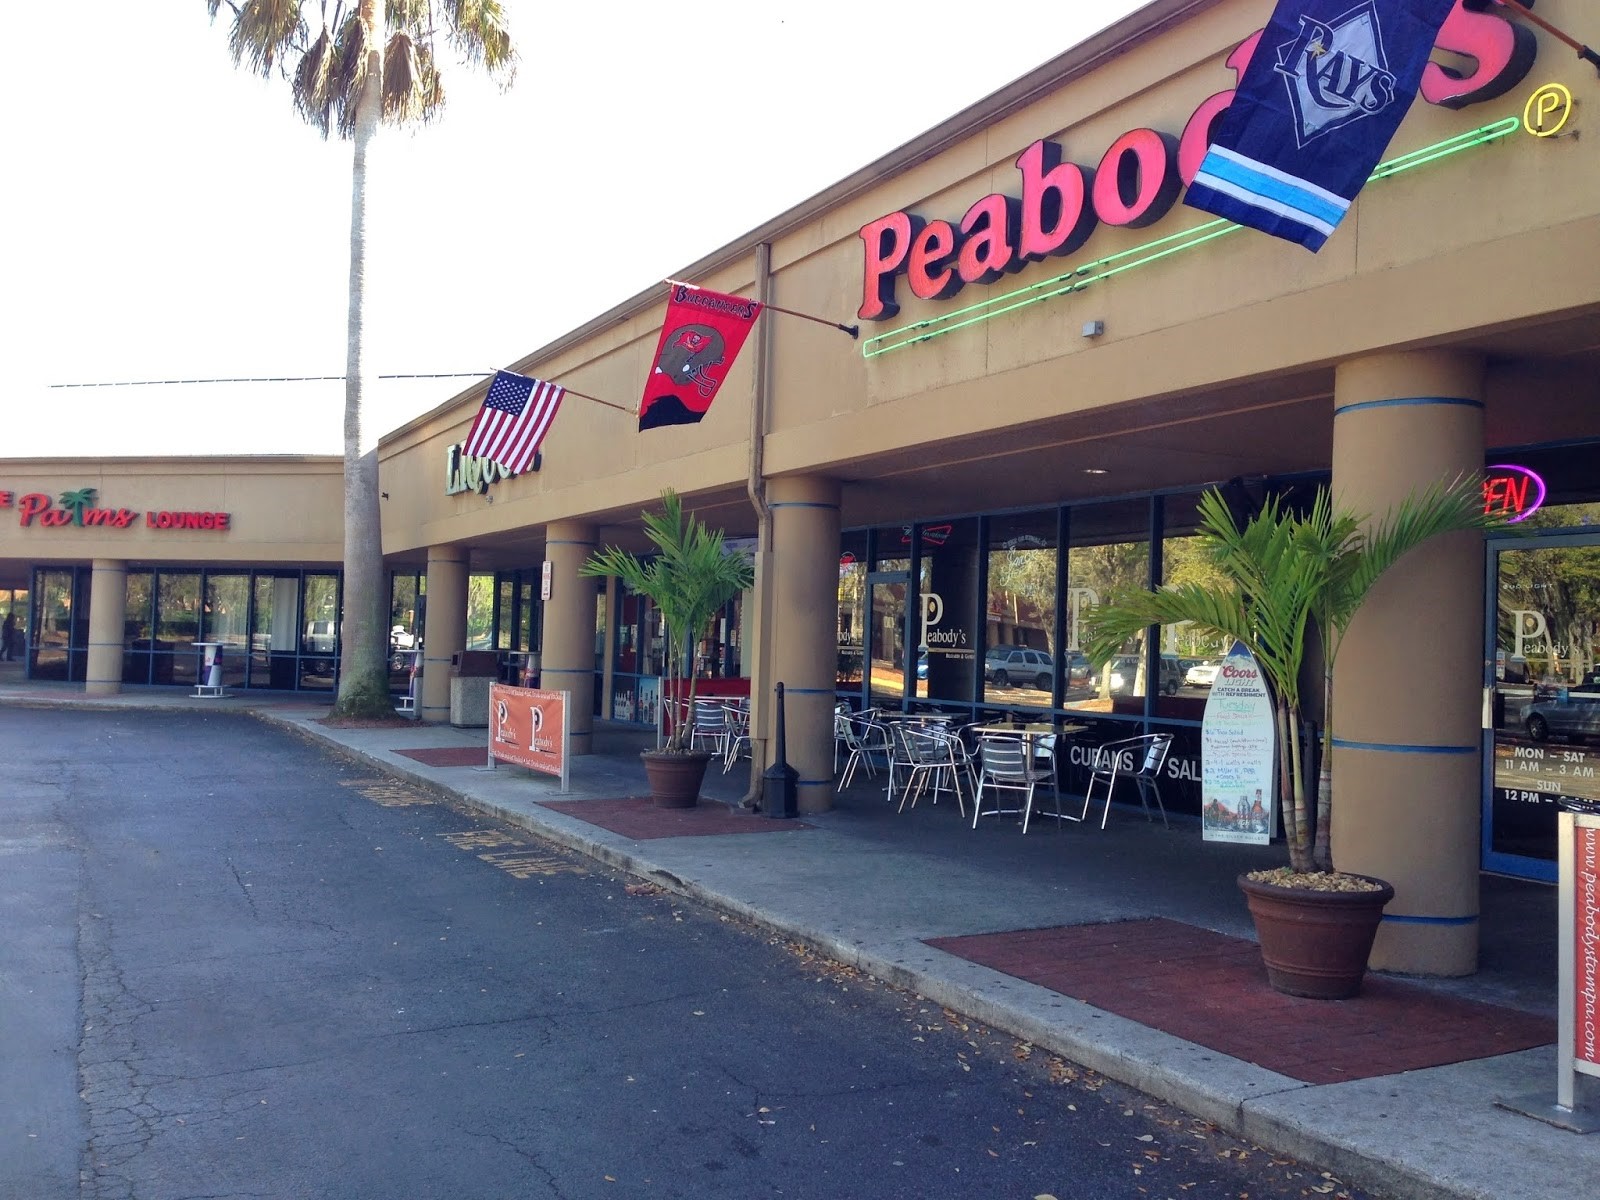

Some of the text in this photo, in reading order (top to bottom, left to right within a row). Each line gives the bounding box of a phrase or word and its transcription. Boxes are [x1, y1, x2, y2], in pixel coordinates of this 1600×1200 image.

[1274, 14, 1397, 116] RAYS
[857, 0, 1536, 321] Peabos
[146, 511, 230, 530] LOUNGE
[917, 592, 967, 651] Peabody's
[1222, 665, 1258, 679] Coors
[1070, 746, 1203, 782] CUBANS SAL
[1514, 747, 1544, 759] MON
[1563, 751, 1585, 763] SAT
[1505, 759, 1514, 769] 11
[1520, 761, 1539, 772] AM
[1560, 764, 1567, 774] 3
[1573, 766, 1594, 778] AM
[1537, 780, 1561, 792] SUN
[1505, 790, 1517, 800] 12
[1521, 791, 1540, 803] PM
[1580, 828, 1600, 1063] www.peabodystampa.com
